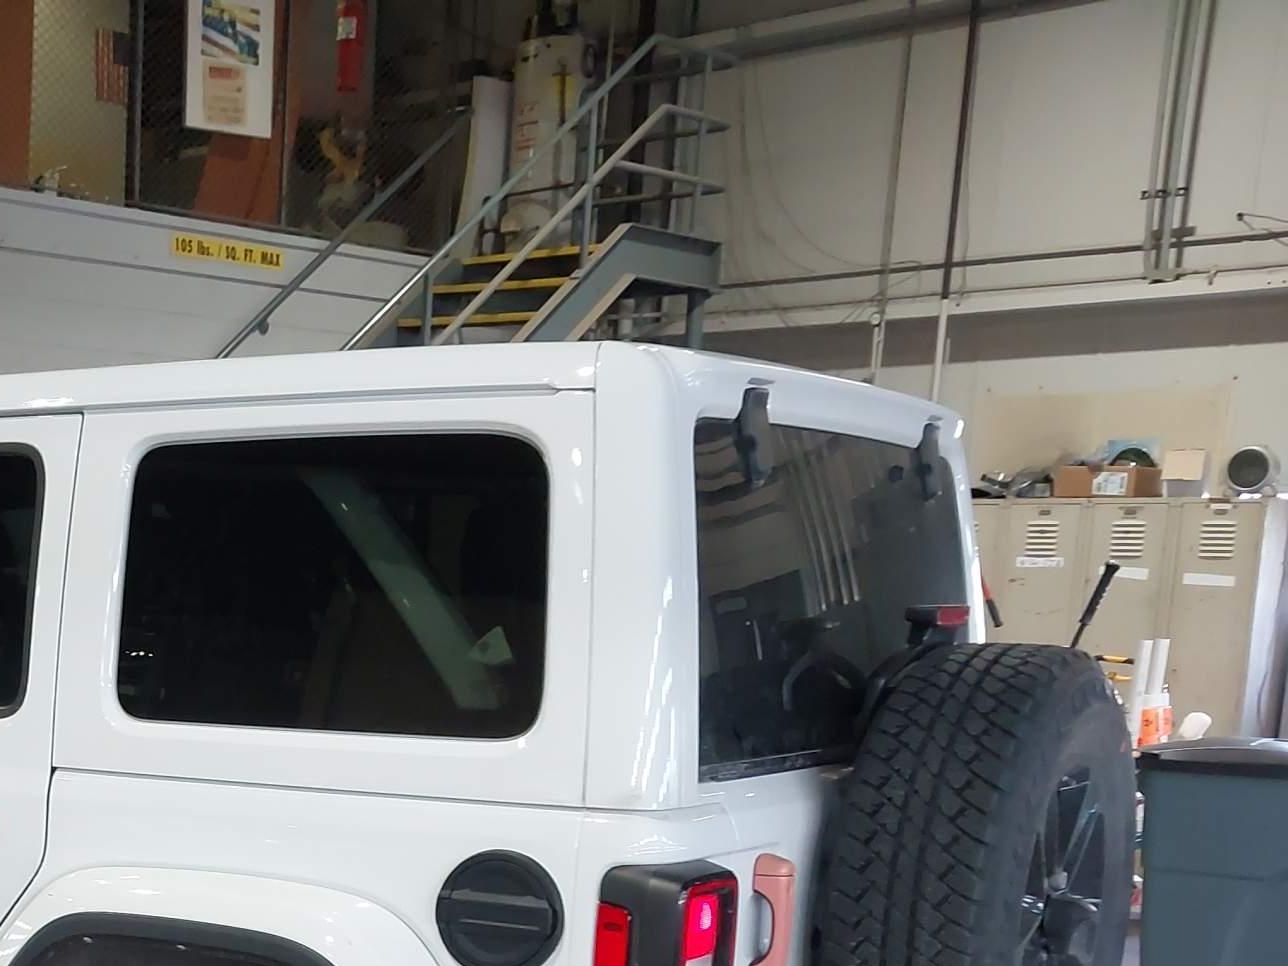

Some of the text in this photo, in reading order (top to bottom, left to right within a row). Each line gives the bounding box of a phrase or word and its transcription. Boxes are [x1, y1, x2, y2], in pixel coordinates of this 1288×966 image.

[175, 237, 193, 254] 105
[197, 240, 214, 256] lbs.
[225, 245, 240, 261] SQ.
[244, 248, 257, 263] FT.
[260, 250, 280, 266] MAX
